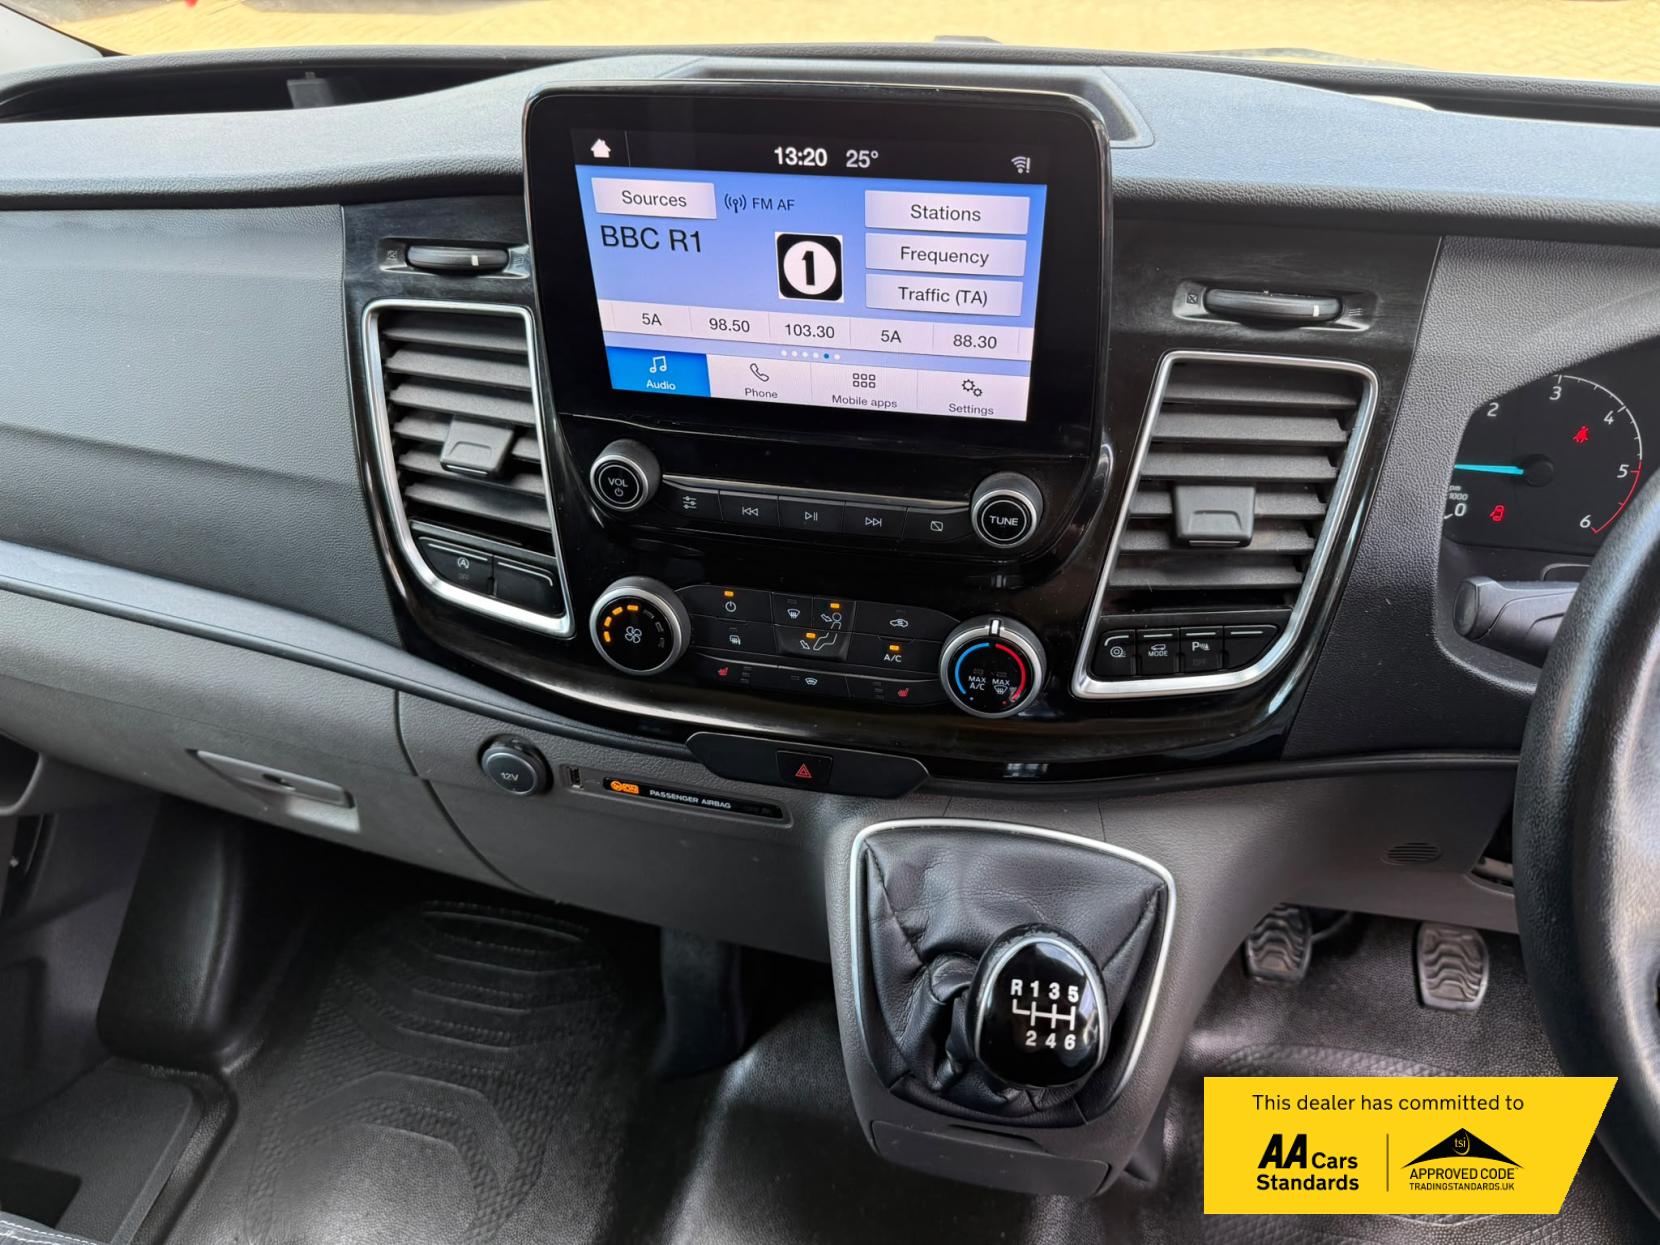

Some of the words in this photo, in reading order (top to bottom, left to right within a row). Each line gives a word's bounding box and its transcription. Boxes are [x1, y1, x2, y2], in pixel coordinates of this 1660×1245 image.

[774, 147, 828, 167] 13:20
[846, 149, 879, 168] 25°
[621, 190, 687, 208] Sources
[752, 197, 773, 211] FM
[777, 199, 795, 211] AF
[910, 204, 981, 222] Stations
[601, 225, 660, 250] BBC
[669, 228, 701, 252] R1
[900, 246, 989, 267] Frequency
[801, 250, 816, 286] 1
[898, 286, 950, 303] Traffic
[955, 289, 988, 307] (TA)
[641, 313, 662, 327] 5A
[709, 318, 751, 333] 98.50
[784, 323, 835, 339] 103.30
[880, 330, 902, 344] 5A
[953, 334, 997, 349] 88.30
[646, 379, 676, 391] Audio
[744, 387, 778, 399] Phone
[1549, 386, 1562, 400] 3
[832, 394, 868, 406] Mobile
[870, 399, 898, 409] apps
[948, 403, 994, 416] Settings
[1486, 402, 1499, 417] 2
[1603, 410, 1614, 425] 4
[1617, 464, 1629, 478] 5
[608, 477, 628, 488] VOL
[1454, 502, 1467, 517] 0
[989, 515, 1019, 527] TUNE
[1579, 514, 1591, 528] 6
[883, 654, 902, 663] A/C
[968, 675, 986, 683] MAX
[969, 682, 985, 691] A/C
[992, 678, 1010, 686] MAX
[501, 772, 519, 781] 12V
[650, 789, 699, 804] PASSENGER
[701, 798, 731, 809] AIRBAG
[1010, 979, 1023, 996] R
[1030, 980, 1039, 998] 1
[1048, 982, 1060, 1000] 3
[1067, 985, 1079, 1003] 5
[1025, 1030, 1037, 1047] 2
[1045, 1033, 1057, 1049] 4
[1064, 1034, 1076, 1050] 6
